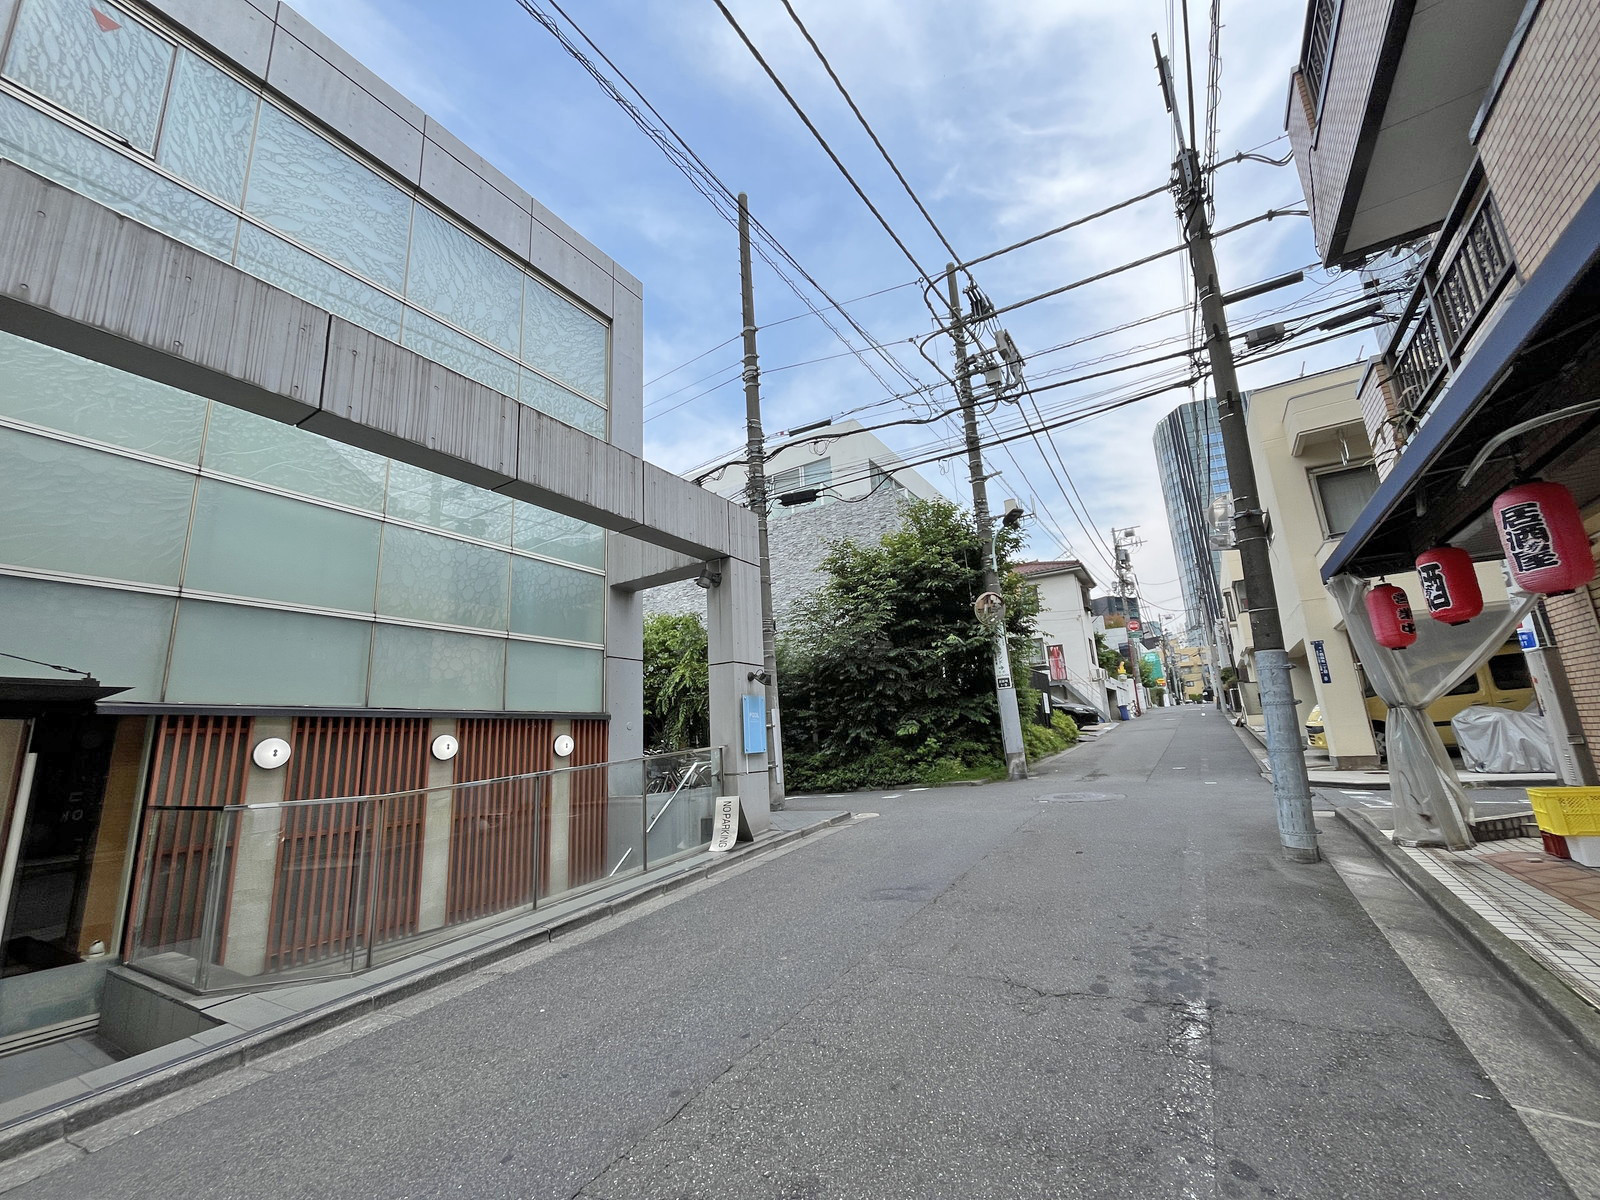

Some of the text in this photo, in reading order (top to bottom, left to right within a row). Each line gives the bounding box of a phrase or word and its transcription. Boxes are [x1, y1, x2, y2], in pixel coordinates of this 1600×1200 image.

[1500, 501, 1561, 573] 居酒屋
[718, 800, 732, 848] NO PARKING
